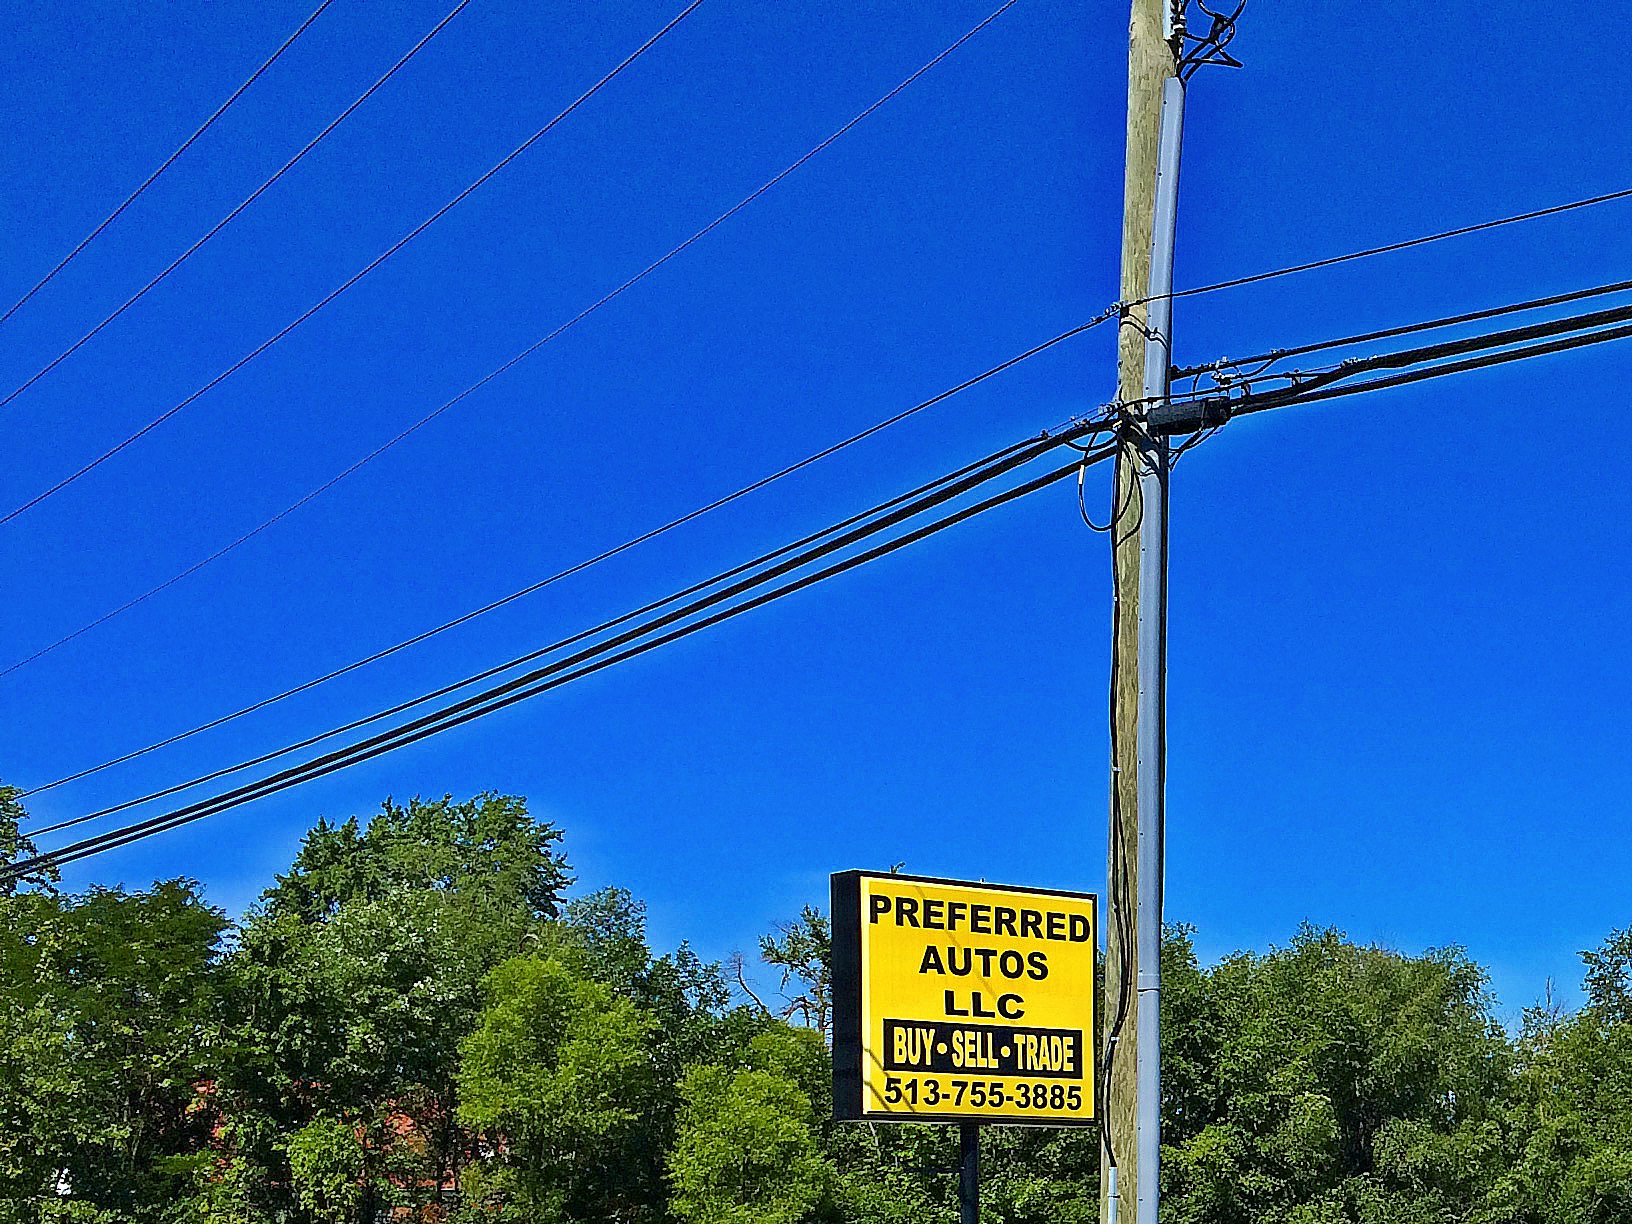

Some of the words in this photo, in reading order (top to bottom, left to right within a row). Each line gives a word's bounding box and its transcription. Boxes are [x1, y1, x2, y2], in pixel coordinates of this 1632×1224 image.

[869, 894, 1091, 943] PREFERRED
[919, 945, 1049, 981] AUTOS
[944, 989, 1025, 1020] LLC
[893, 1026, 936, 1066] BUY
[951, 1030, 999, 1069] SELL
[1013, 1033, 1075, 1072] TRADE
[884, 1077, 1082, 1111] 513-755-3885
